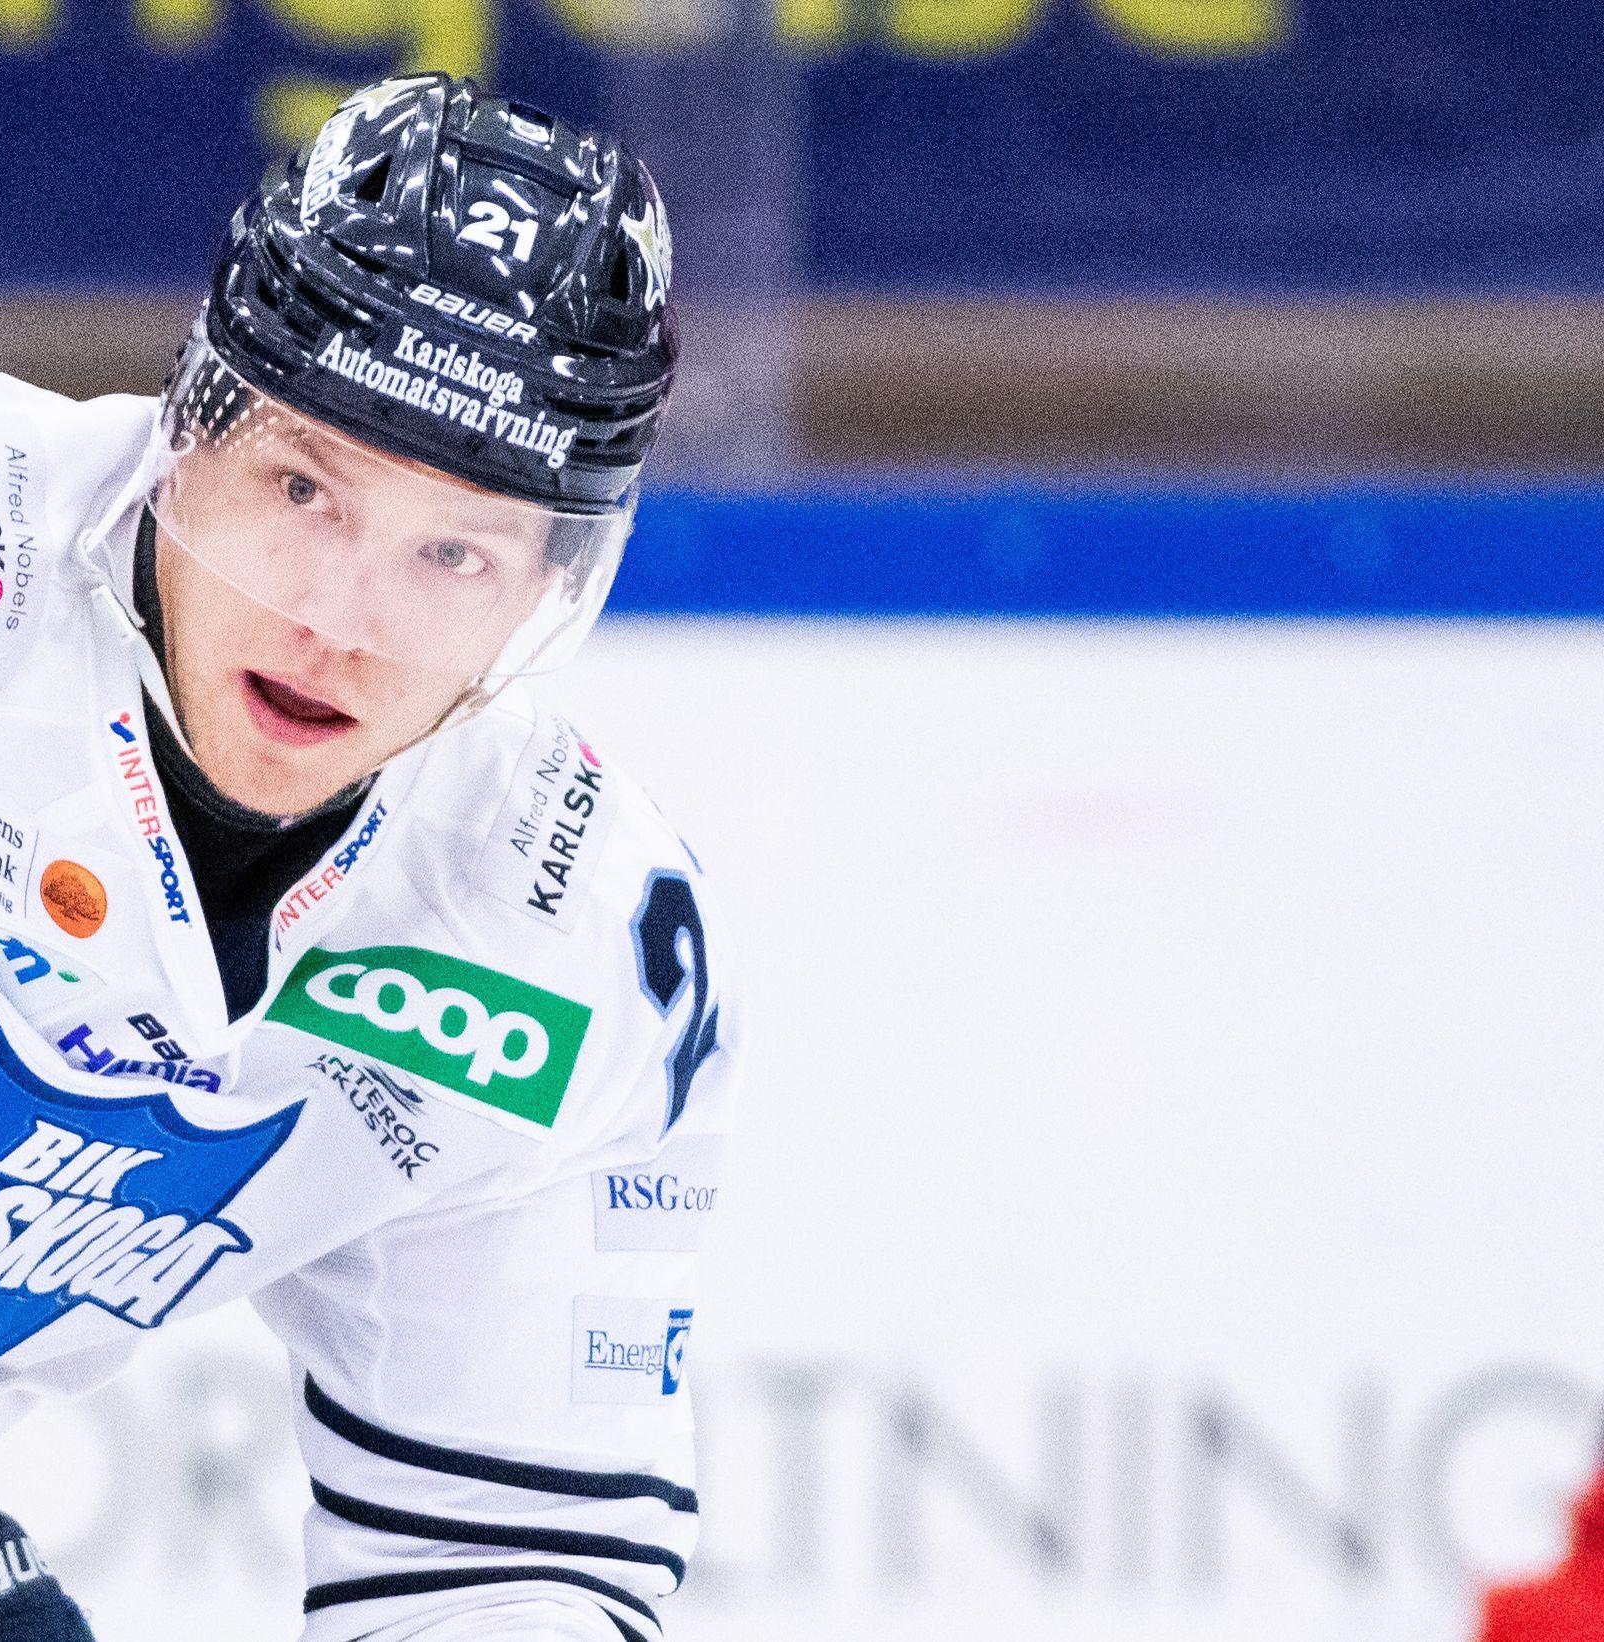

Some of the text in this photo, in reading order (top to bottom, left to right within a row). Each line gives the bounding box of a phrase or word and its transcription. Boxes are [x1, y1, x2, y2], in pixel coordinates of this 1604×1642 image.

[456, 201, 539, 262] 21
[318, 332, 575, 469] Automatsvarvning
[394, 326, 524, 411] Karlskoga
[5, 444, 38, 631] Alfred Nobels
[118, 747, 191, 926] INTERSPORT
[509, 786, 548, 858] Alfred
[304, 963, 550, 1087] coop
[607, 1174, 678, 1211] RSG
[585, 1329, 664, 1376] Energi
